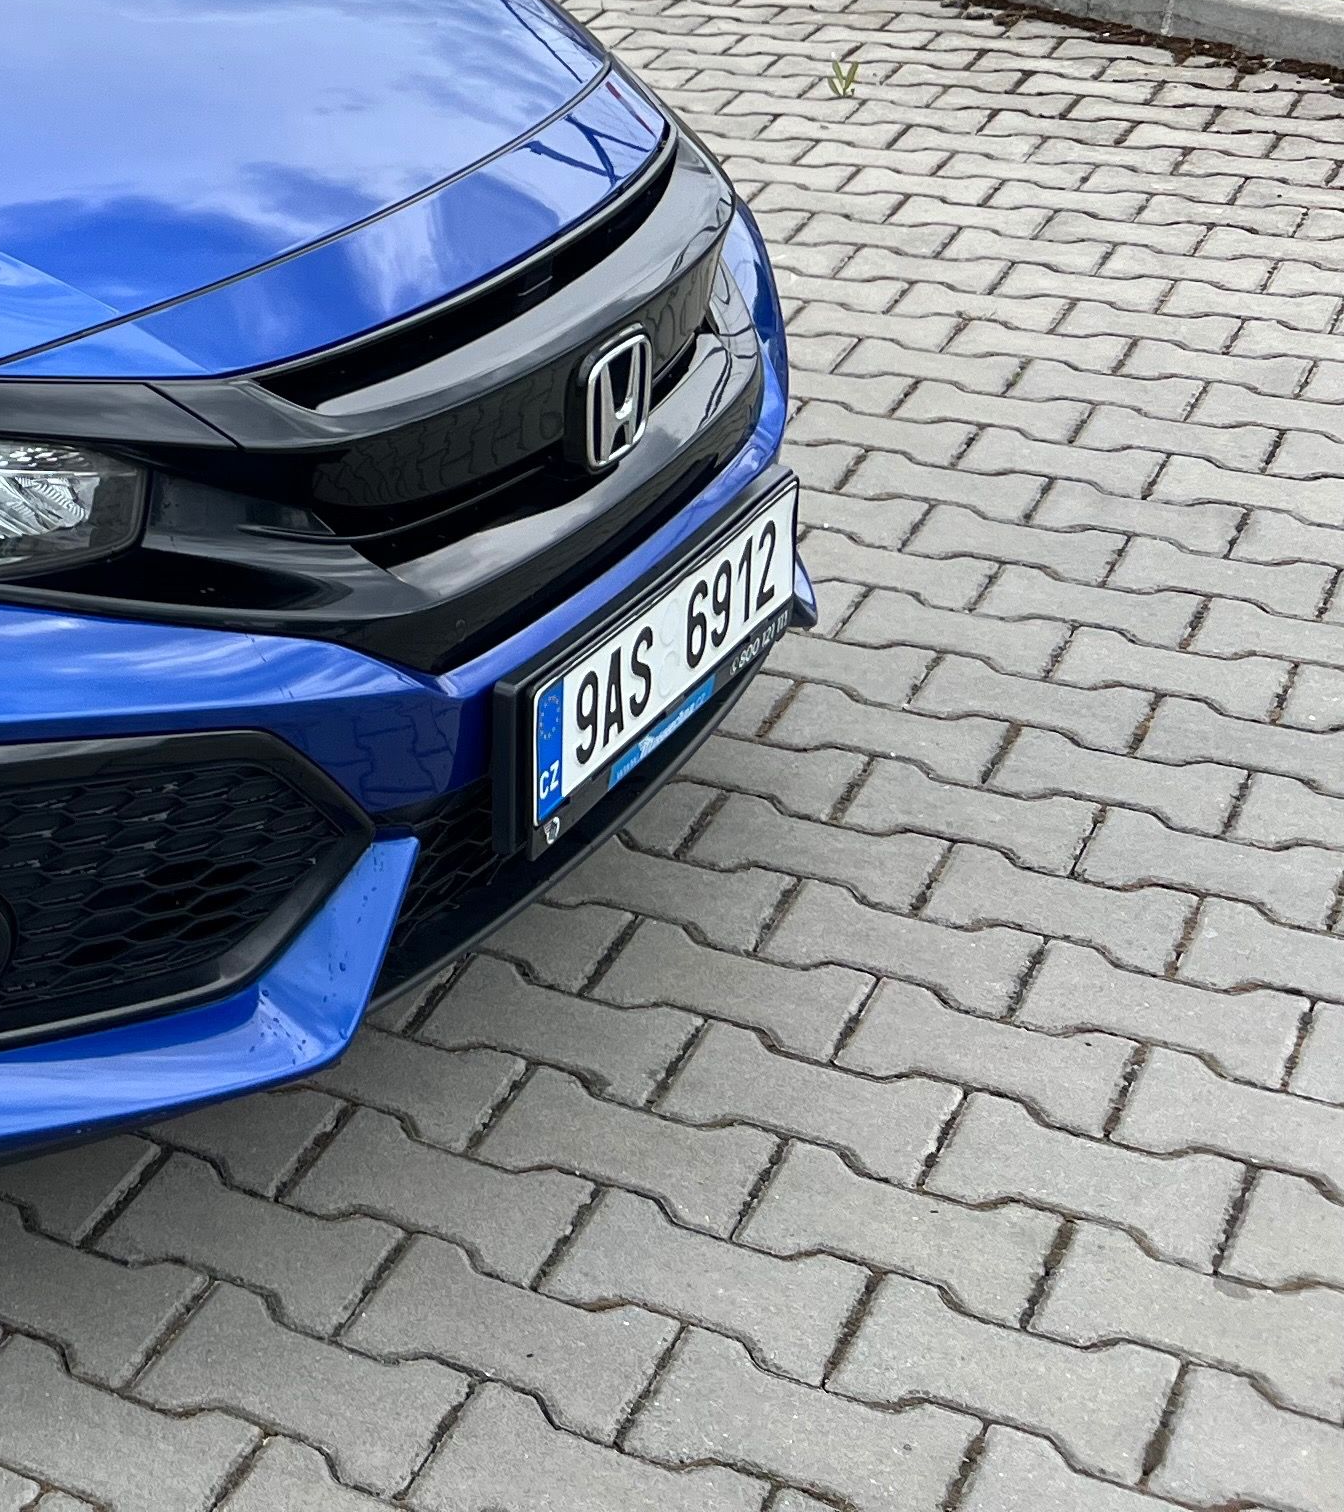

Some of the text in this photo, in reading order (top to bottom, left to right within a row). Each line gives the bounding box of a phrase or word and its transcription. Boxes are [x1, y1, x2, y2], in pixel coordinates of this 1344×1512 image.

[575, 625, 654, 765] 9AS
[685, 519, 777, 670] 6912
[539, 759, 560, 800] CZ
